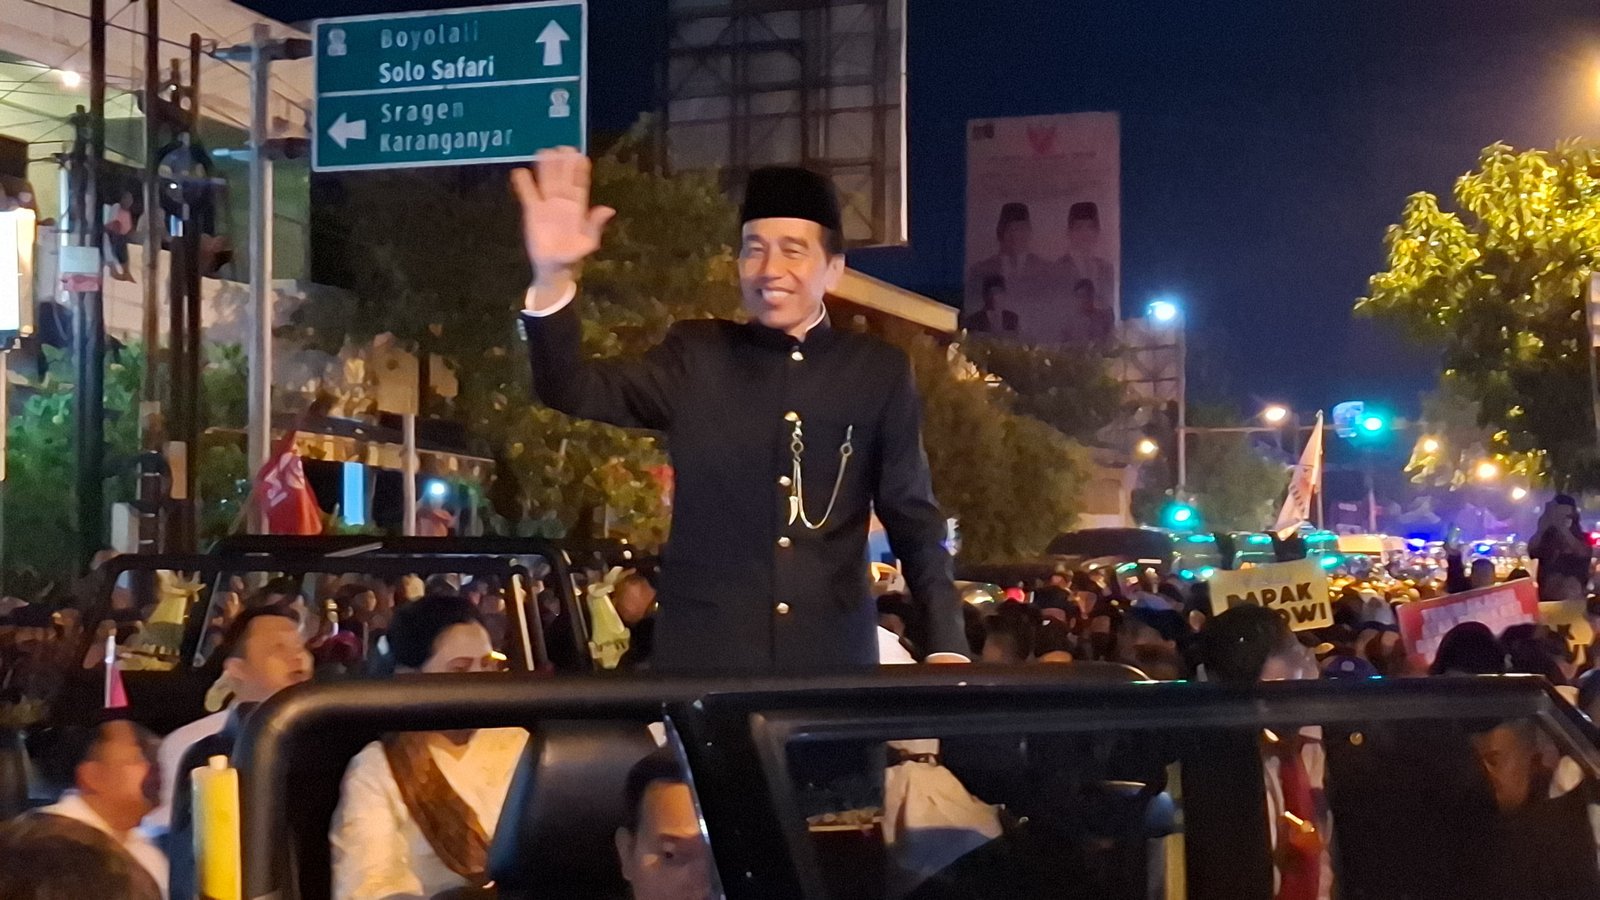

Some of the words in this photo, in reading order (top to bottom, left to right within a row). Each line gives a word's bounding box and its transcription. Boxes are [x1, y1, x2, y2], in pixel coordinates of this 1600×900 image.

[381, 20, 479, 51] Boyolali
[379, 60, 426, 84] Solo
[431, 55, 494, 80] Safari
[381, 102, 464, 126] Sragen
[380, 129, 513, 155] Karanganyar
